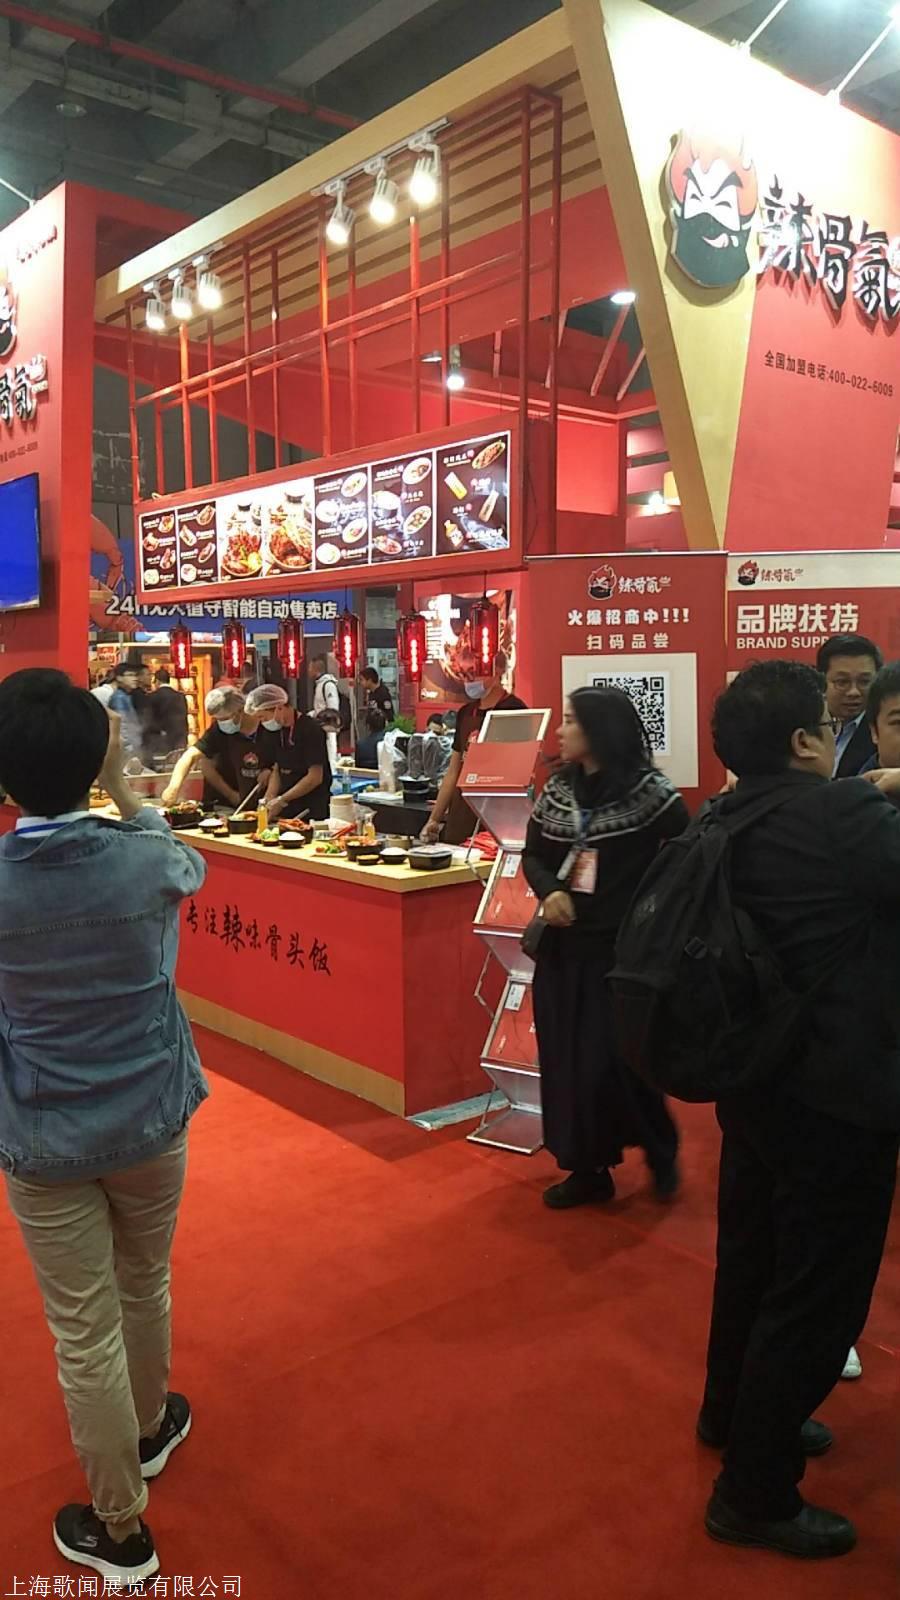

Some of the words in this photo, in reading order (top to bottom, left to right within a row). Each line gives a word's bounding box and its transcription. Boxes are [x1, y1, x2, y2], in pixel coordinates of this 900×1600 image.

[736, 603, 859, 634] 品牌扶持
[586, 632, 670, 650] 扫码品尝
[736, 637, 787, 649] BRAND
[186, 899, 331, 977] 专注辣味骨头饭
